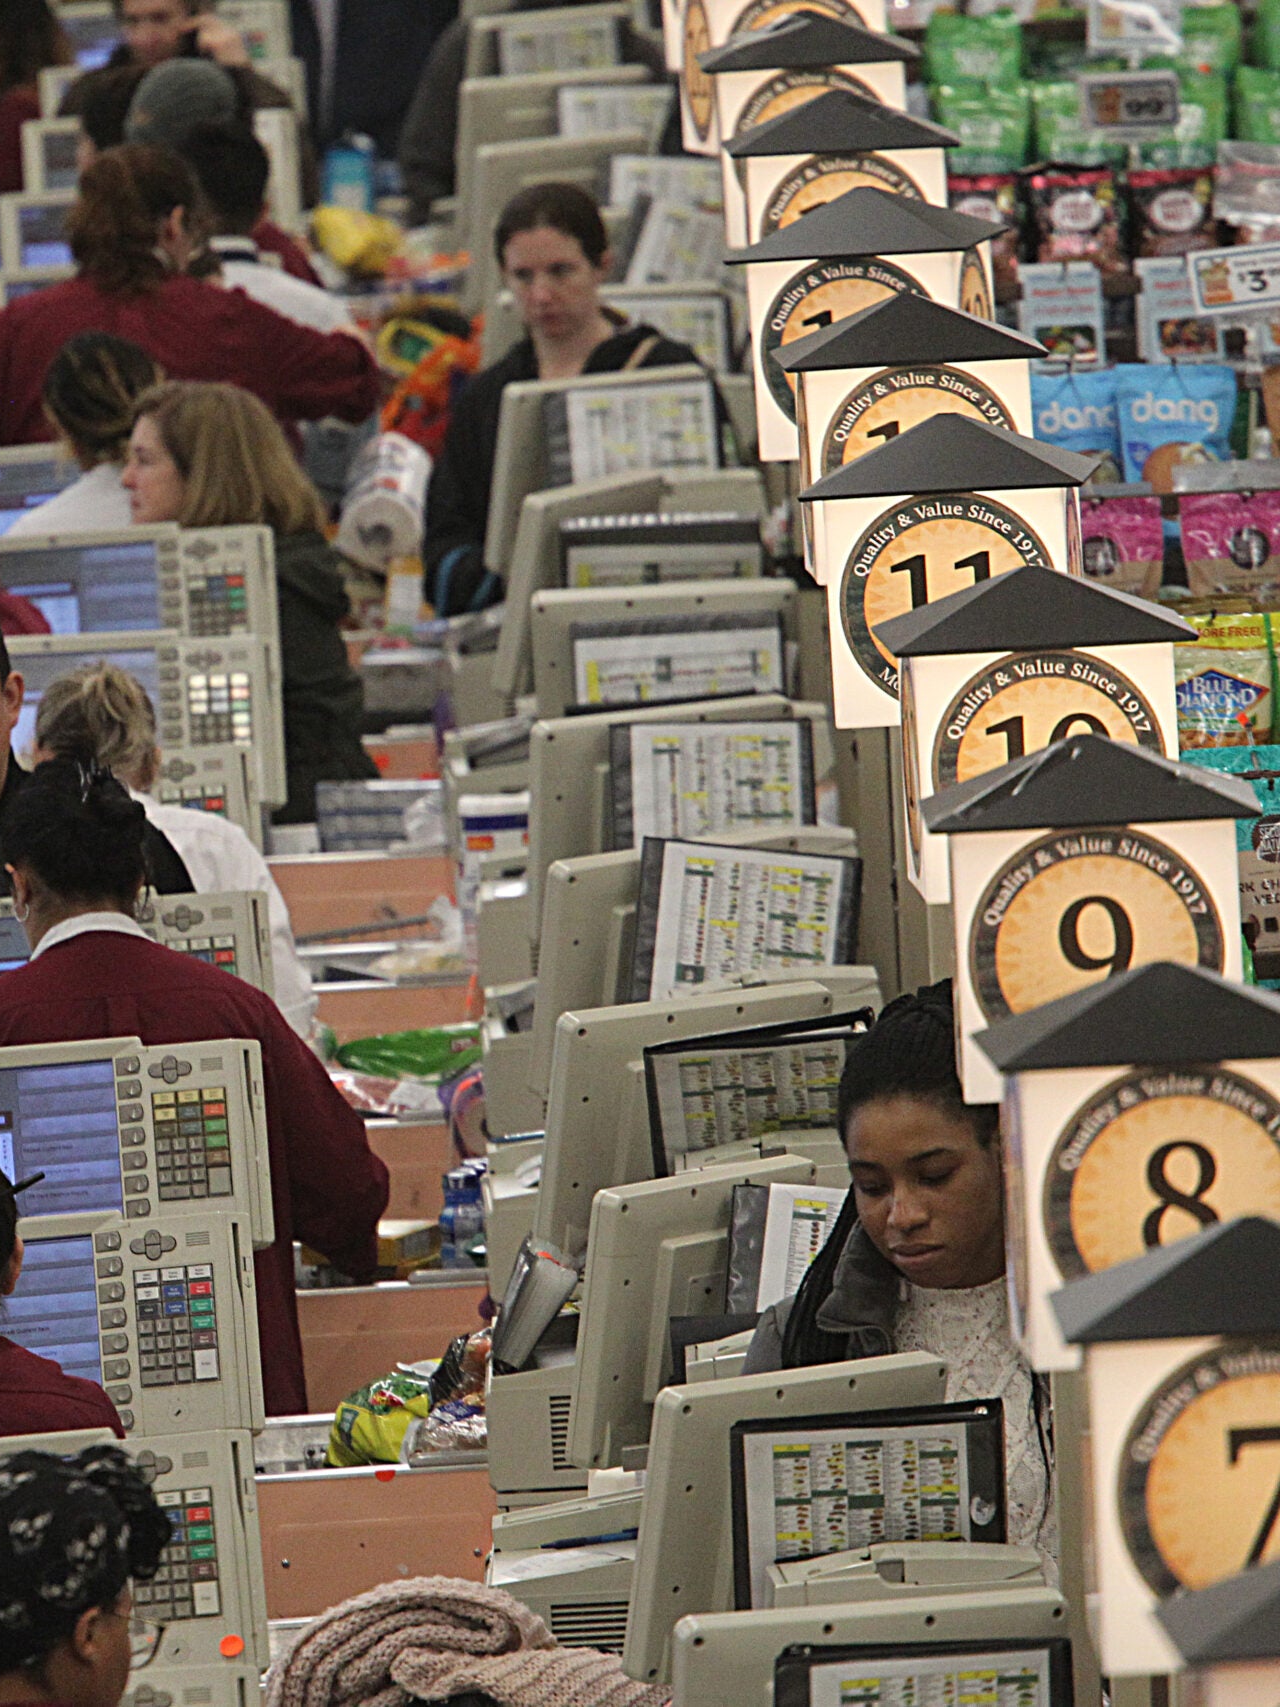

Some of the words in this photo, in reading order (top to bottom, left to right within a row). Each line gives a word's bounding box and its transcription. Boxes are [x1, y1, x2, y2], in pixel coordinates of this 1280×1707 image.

[771, 177, 804, 221] Quality
[818, 157, 860, 172] Value
[771, 282, 807, 331] Quality
[807, 276, 820, 289] &
[821, 264, 864, 280] Value
[867, 266, 906, 291] Since
[833, 393, 874, 443] Quality
[873, 383, 889, 396] &
[889, 373, 935, 388] Value
[939, 375, 980, 402] Since
[980, 399, 1010, 432] 1917
[1131, 391, 1220, 433] dang
[854, 525, 897, 577] Quality
[897, 513, 913, 527] &
[914, 502, 963, 518] Value
[968, 505, 1012, 534] Since
[1007, 531, 1044, 567] 1917
[878, 667, 900, 691] Mo
[947, 682, 994, 740] Quality
[995, 671, 1012, 687] &
[1013, 659, 1065, 678] Value
[1070, 663, 1118, 695] Since
[1118, 692, 1151, 732] 1917
[1176, 688, 1257, 709] DIAMOND
[1192, 677, 1235, 693] BLUE
[983, 862, 1035, 927] Quality
[1035, 850, 1054, 867] &
[1056, 835, 1113, 857] Value
[1117, 839, 1170, 873] Since
[1171, 870, 1207, 915] 1917
[1059, 895, 1133, 983] 9
[1058, 1101, 1119, 1172] Quality
[1140, 1075, 1206, 1097] Value
[1209, 1077, 1267, 1120] Since
[1142, 1140, 1221, 1248] 8
